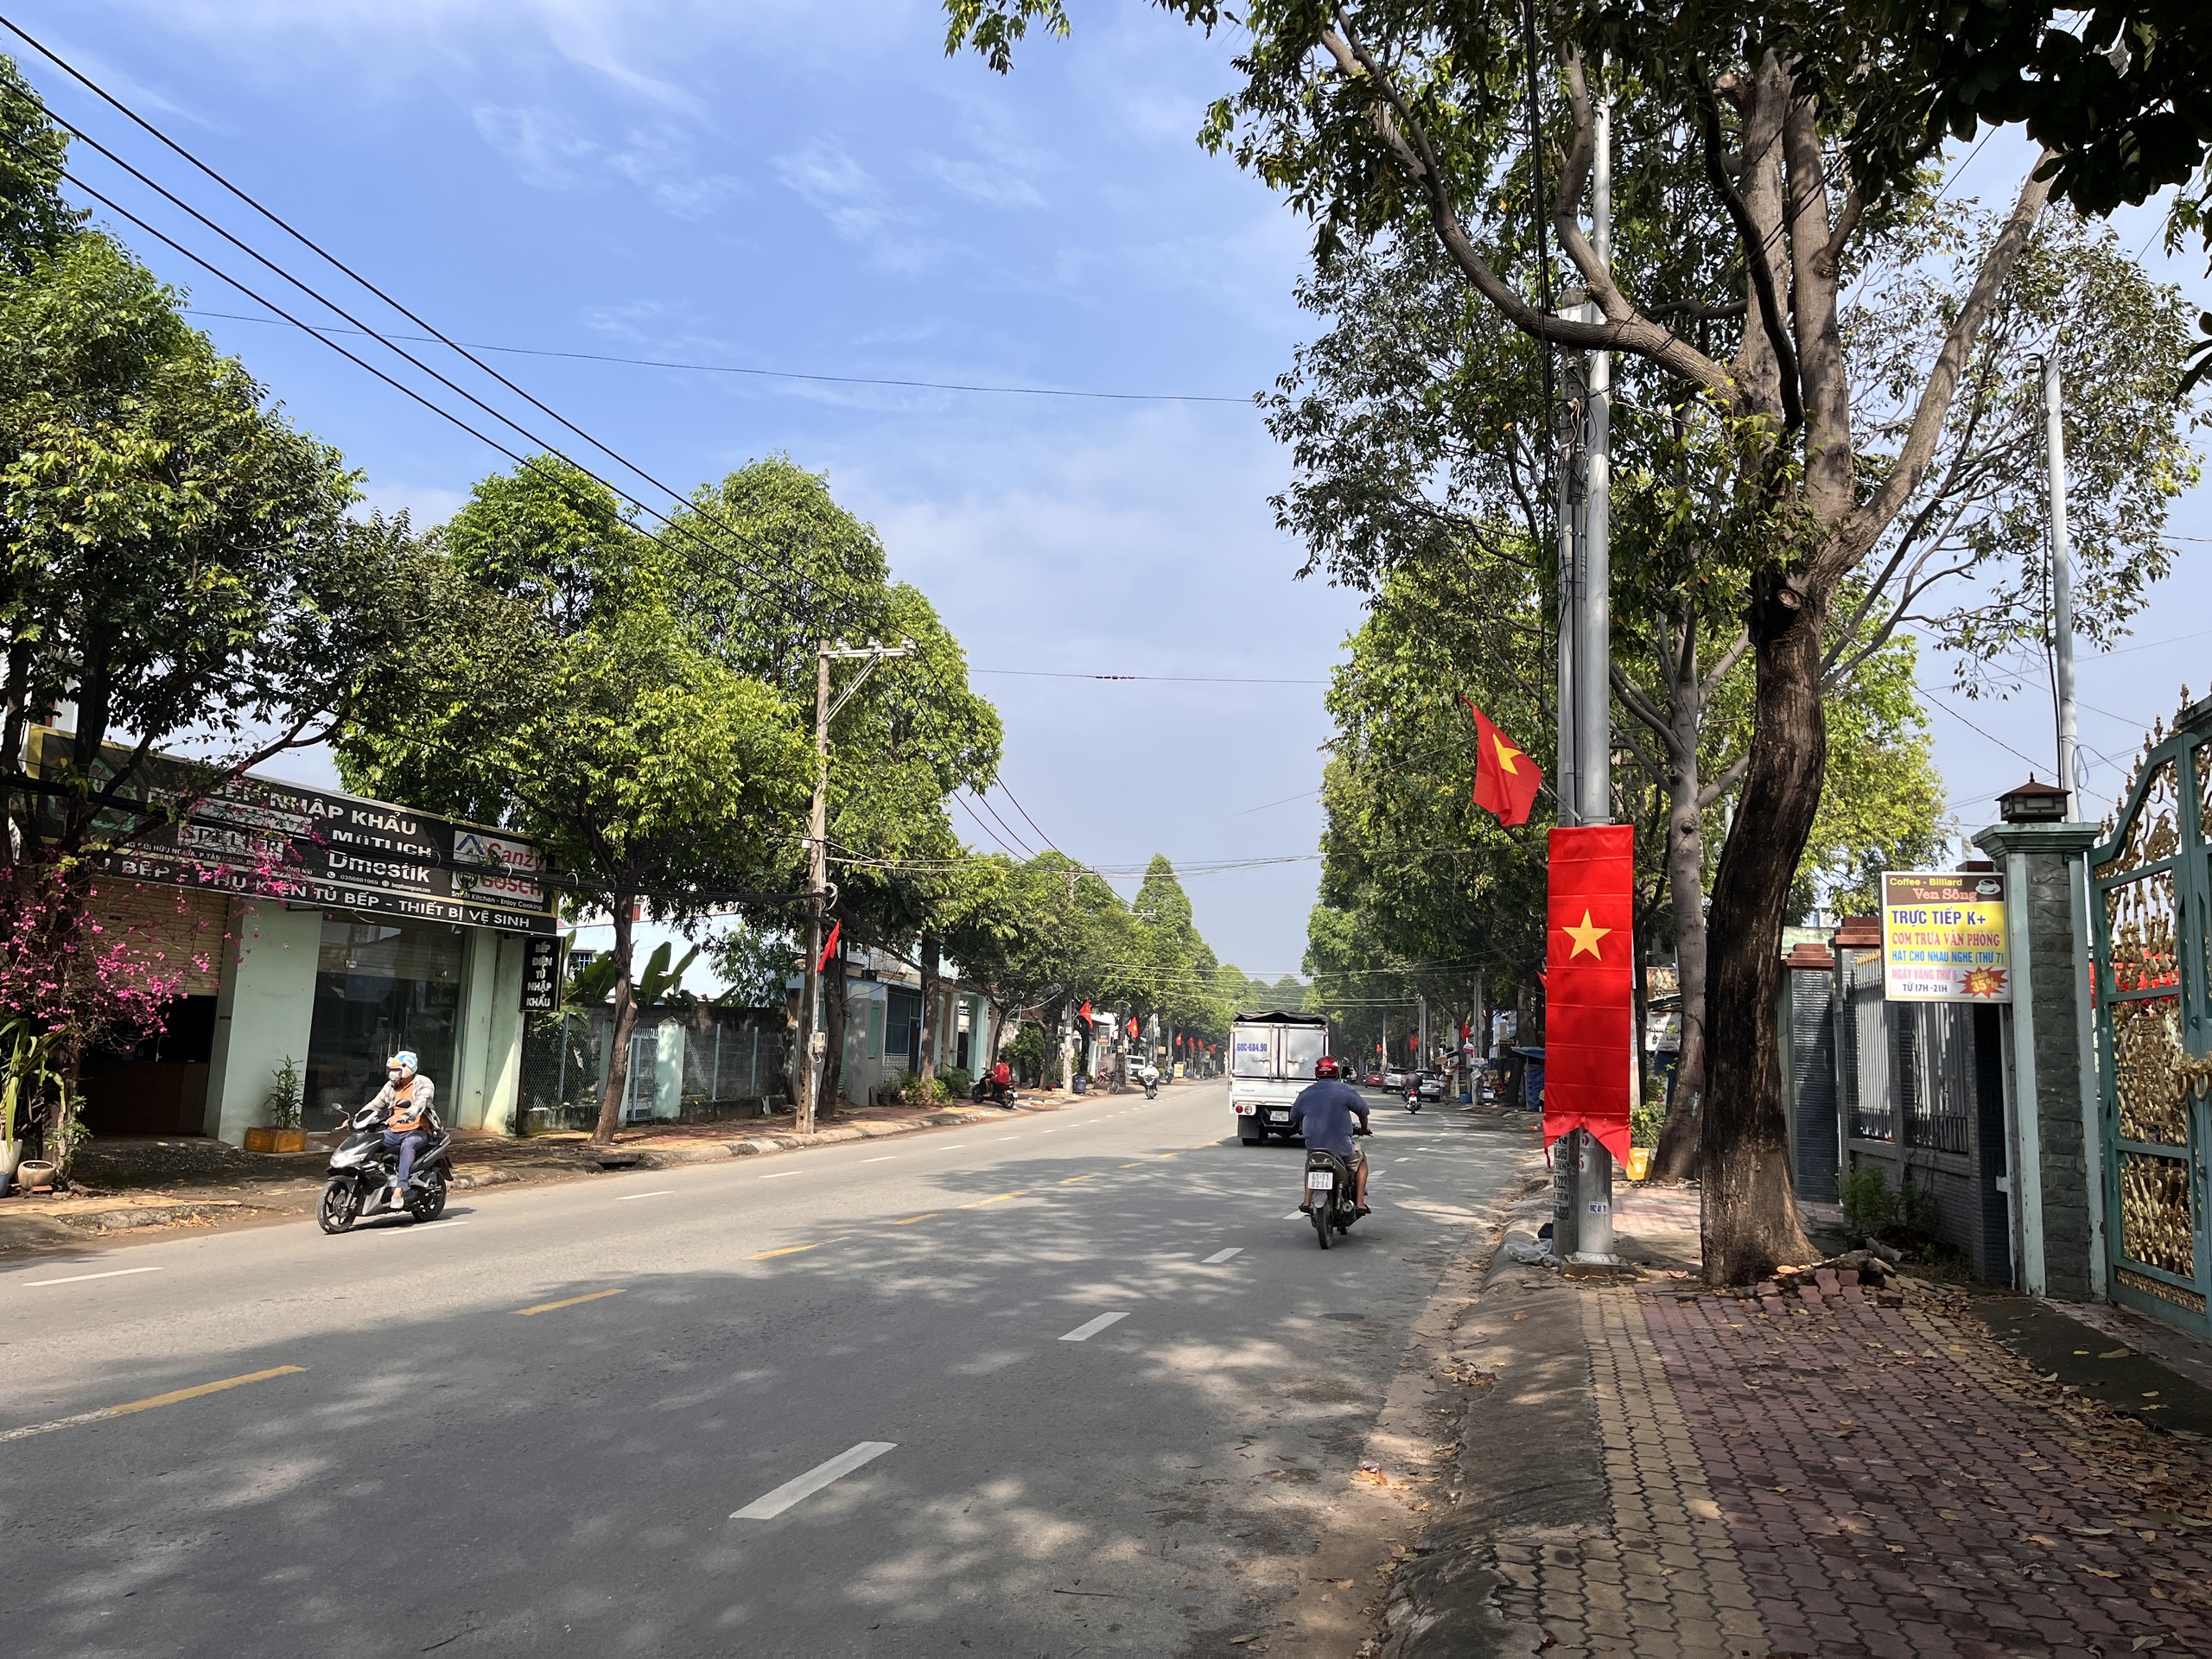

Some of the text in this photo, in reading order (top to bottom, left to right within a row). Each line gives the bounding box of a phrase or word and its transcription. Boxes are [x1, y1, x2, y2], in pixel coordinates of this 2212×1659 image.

[352, 811, 416, 836] KHẨU
[1889, 878, 1922, 887] Coffee
[1929, 878, 1963, 887] Billiard
[1912, 887, 1978, 902] Ven Sông
[314, 886, 337, 901] TỦ
[344, 891, 379, 907] BẾP
[398, 900, 444, 917] THIẾT
[448, 906, 464, 921] BỊ
[469, 910, 490, 925] VỆ
[493, 913, 530, 928] SINH
[471, 893, 496, 904] Kitchen
[500, 898, 518, 908] Enjoy
[518, 900, 543, 912] Cooking
[1891, 906, 1986, 927] TRỰC TIẾP K+
[1891, 931, 1912, 945] CƠM
[1914, 931, 1942, 946] TRƯA
[1967, 930, 2000, 947] PHÒNG
[535, 940, 551, 954] BẾP
[1891, 949, 2005, 965] HÁT CHO NHAU NGHE (THỨ 7)
[1952, 969, 1958, 982] 6
[527, 979, 552, 994] NHẬP
[1903, 982, 1914, 993] TỪ
[1971, 976, 2000, 994] 35%
[525, 993, 550, 1007] KHẨU
[1236, 1042, 1268, 1052] 60C-684.90
